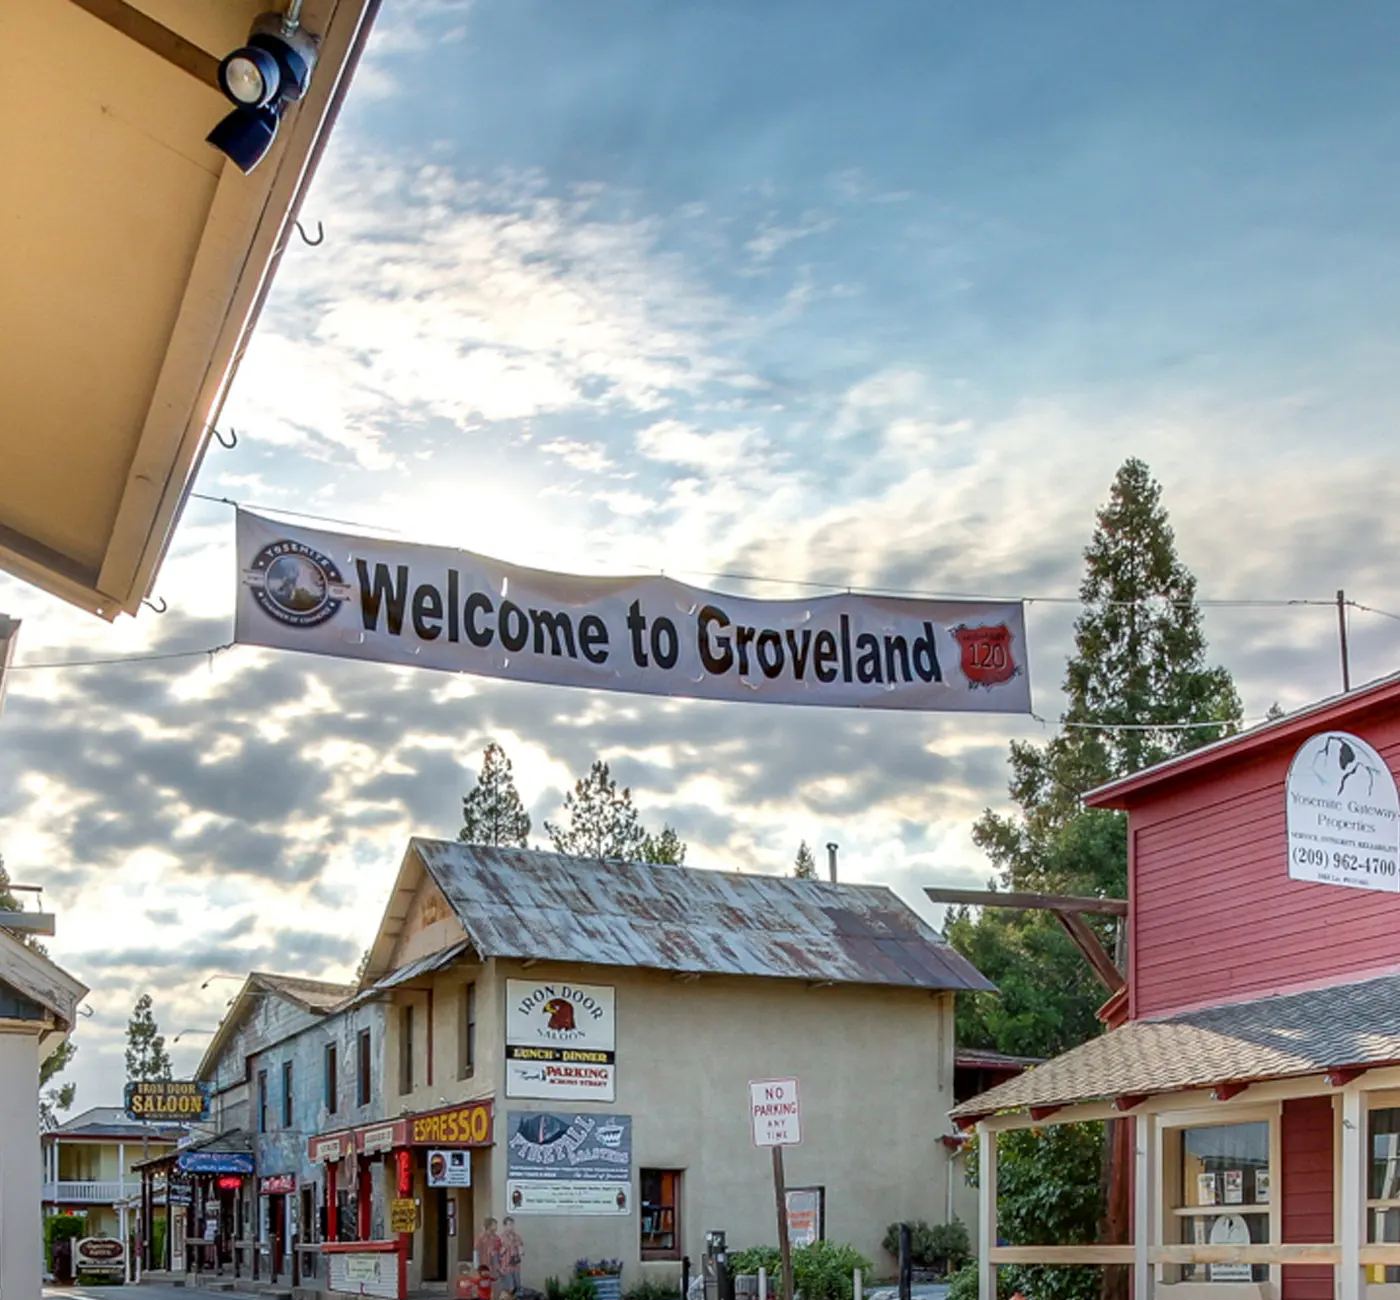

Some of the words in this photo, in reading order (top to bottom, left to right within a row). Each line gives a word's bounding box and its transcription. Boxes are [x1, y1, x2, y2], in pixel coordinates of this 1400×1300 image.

[265, 543, 330, 567] YOSEMITE
[356, 558, 609, 665] Welcome
[627, 599, 679, 670] to
[698, 605, 943, 684] Groveland
[969, 642, 1007, 670] 120
[1290, 791, 1342, 811] Yosemite
[1347, 801, 1397, 821] Gateway
[1317, 813, 1376, 833] Properties
[1292, 847, 1329, 869] (209)
[1333, 852, 1396, 876] 962-4700
[518, 985, 557, 1015] IRON
[561, 986, 604, 1020] DOOR
[537, 1027, 586, 1040] SALOON
[513, 1048, 554, 1060] LUNCH
[562, 1050, 608, 1063] DINNER
[546, 1066, 608, 1079] PARKING
[137, 1083, 165, 1094] IRON
[167, 1083, 197, 1094] DOOR
[765, 1087, 784, 1100] NO
[131, 1095, 203, 1113] SALOON
[754, 1101, 797, 1117] PARKING
[414, 1106, 488, 1142] ESPRESSO
[767, 1120, 785, 1128] ANY
[767, 1131, 788, 1141] TIME
